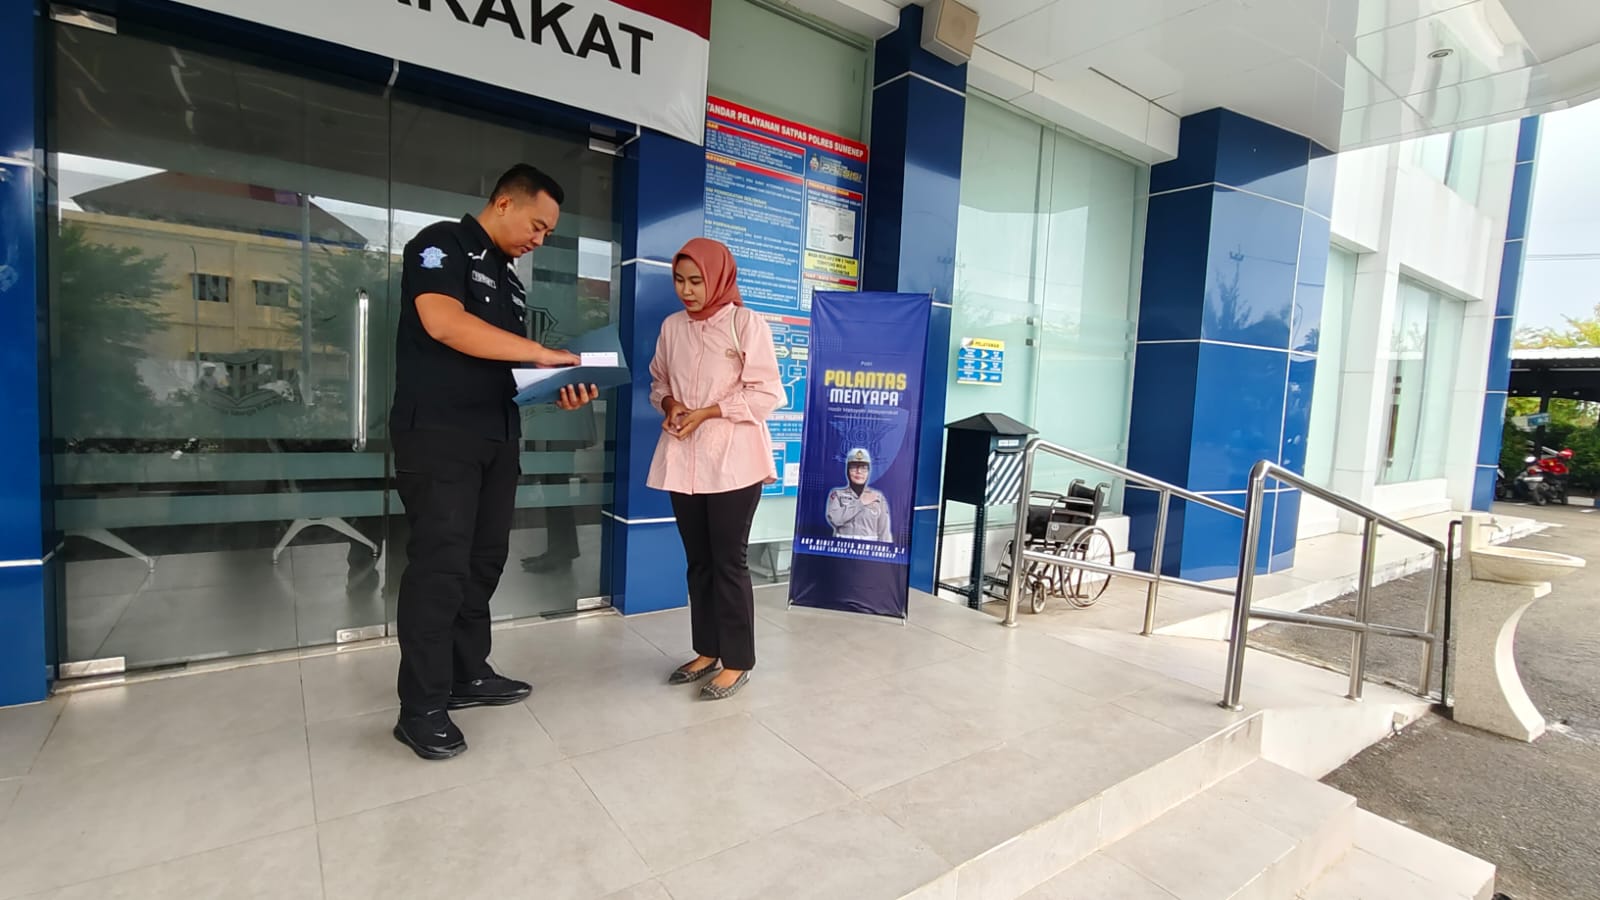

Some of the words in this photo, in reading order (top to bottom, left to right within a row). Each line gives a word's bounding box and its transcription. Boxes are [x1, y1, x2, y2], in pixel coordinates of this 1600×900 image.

[396, 0, 654, 75] AKAT
[737, 111, 781, 133] PELAYANAN
[781, 125, 807, 142] SATPAS
[808, 133, 834, 150] POLRES
[834, 140, 864, 158] SUMENEP
[824, 369, 907, 391] POLANTAS
[829, 388, 899, 406] MENYAPA
